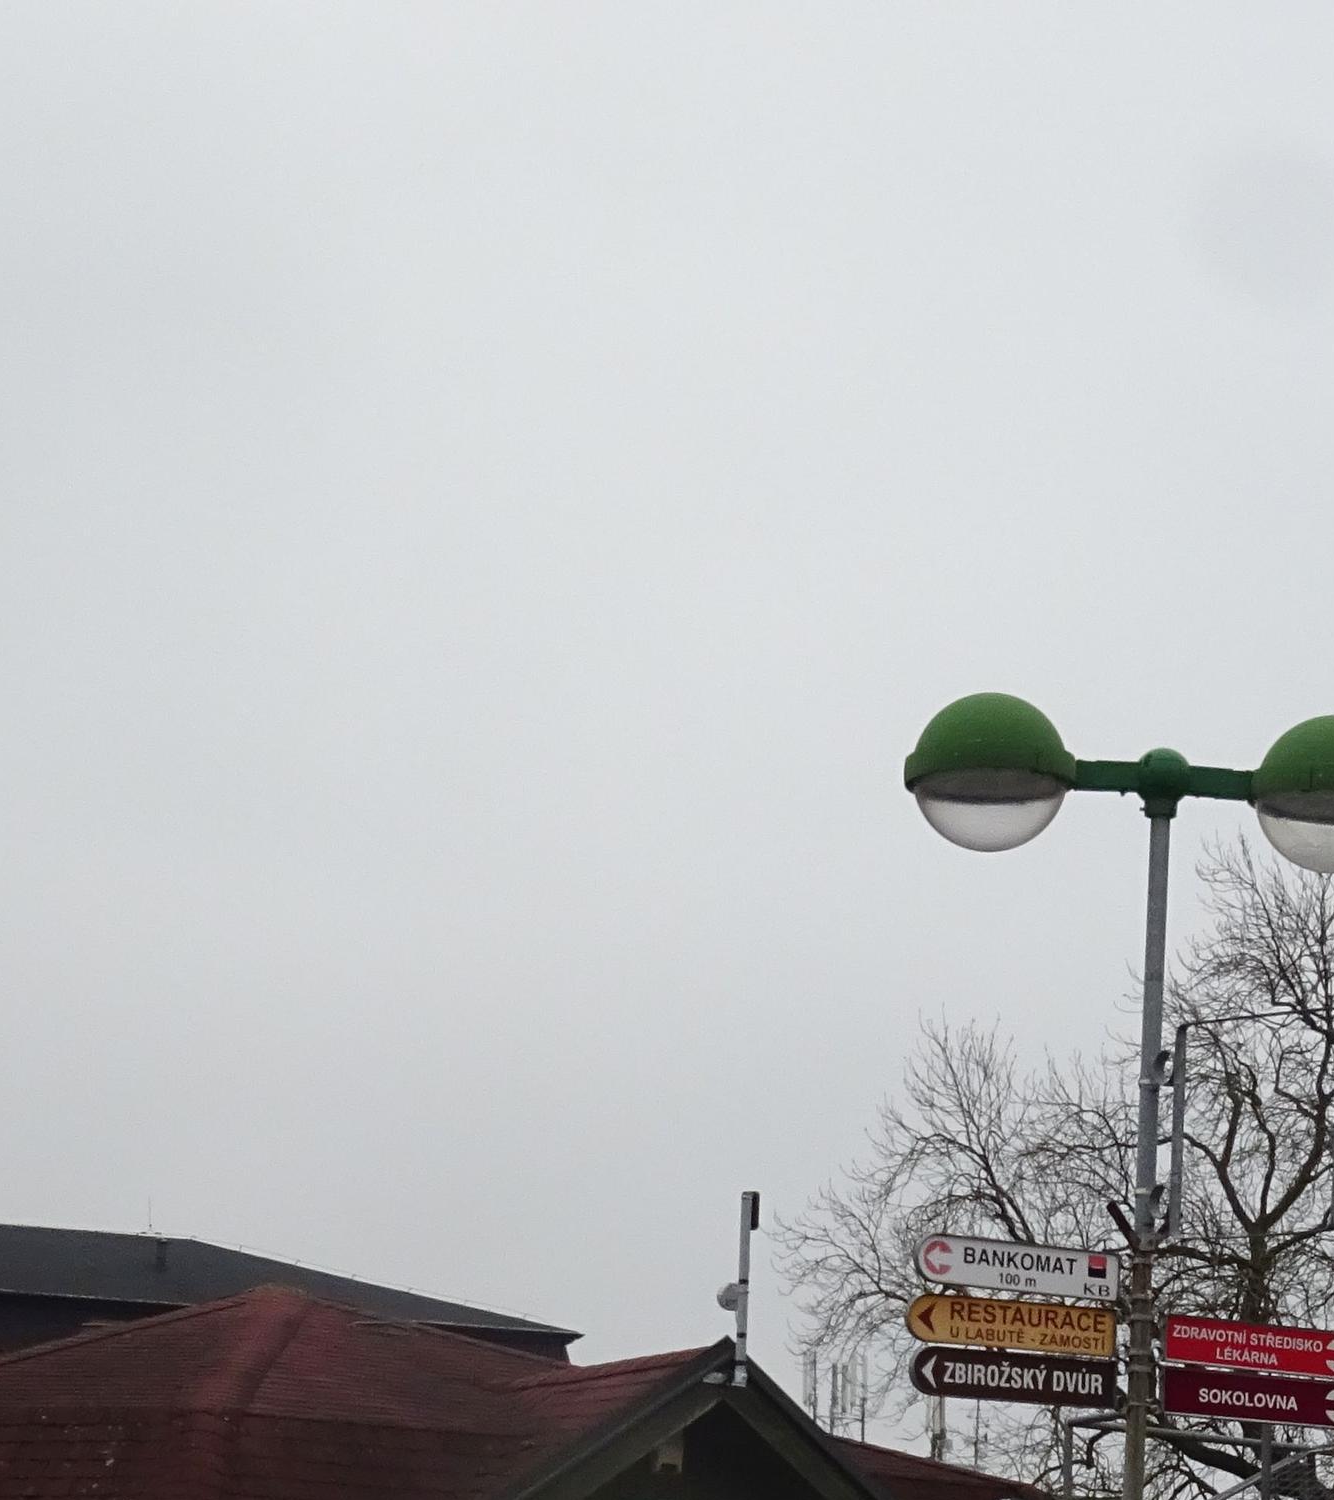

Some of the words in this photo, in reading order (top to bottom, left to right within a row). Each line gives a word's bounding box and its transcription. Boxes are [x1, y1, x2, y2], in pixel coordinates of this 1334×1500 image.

[963, 1247, 1077, 1275] BANKOMAT
[999, 1273, 1020, 1287] 100
[1025, 1278, 1037, 1288] m
[1083, 1283, 1111, 1297] KB
[950, 1301, 1107, 1333] RESTAURACE
[950, 1326, 960, 1338] U
[966, 1327, 1025, 1344] LABUTĚ
[1173, 1325, 1247, 1344] ZDRAVOTNÍ
[1250, 1332, 1323, 1353] STŘEDISKO
[1216, 1346, 1279, 1365] LÉKÁRNA
[943, 1361, 1047, 1391] ZBIROŽSKÝ
[1053, 1368, 1103, 1396] DVŮR
[1199, 1388, 1299, 1411] SOKOLOVNA
